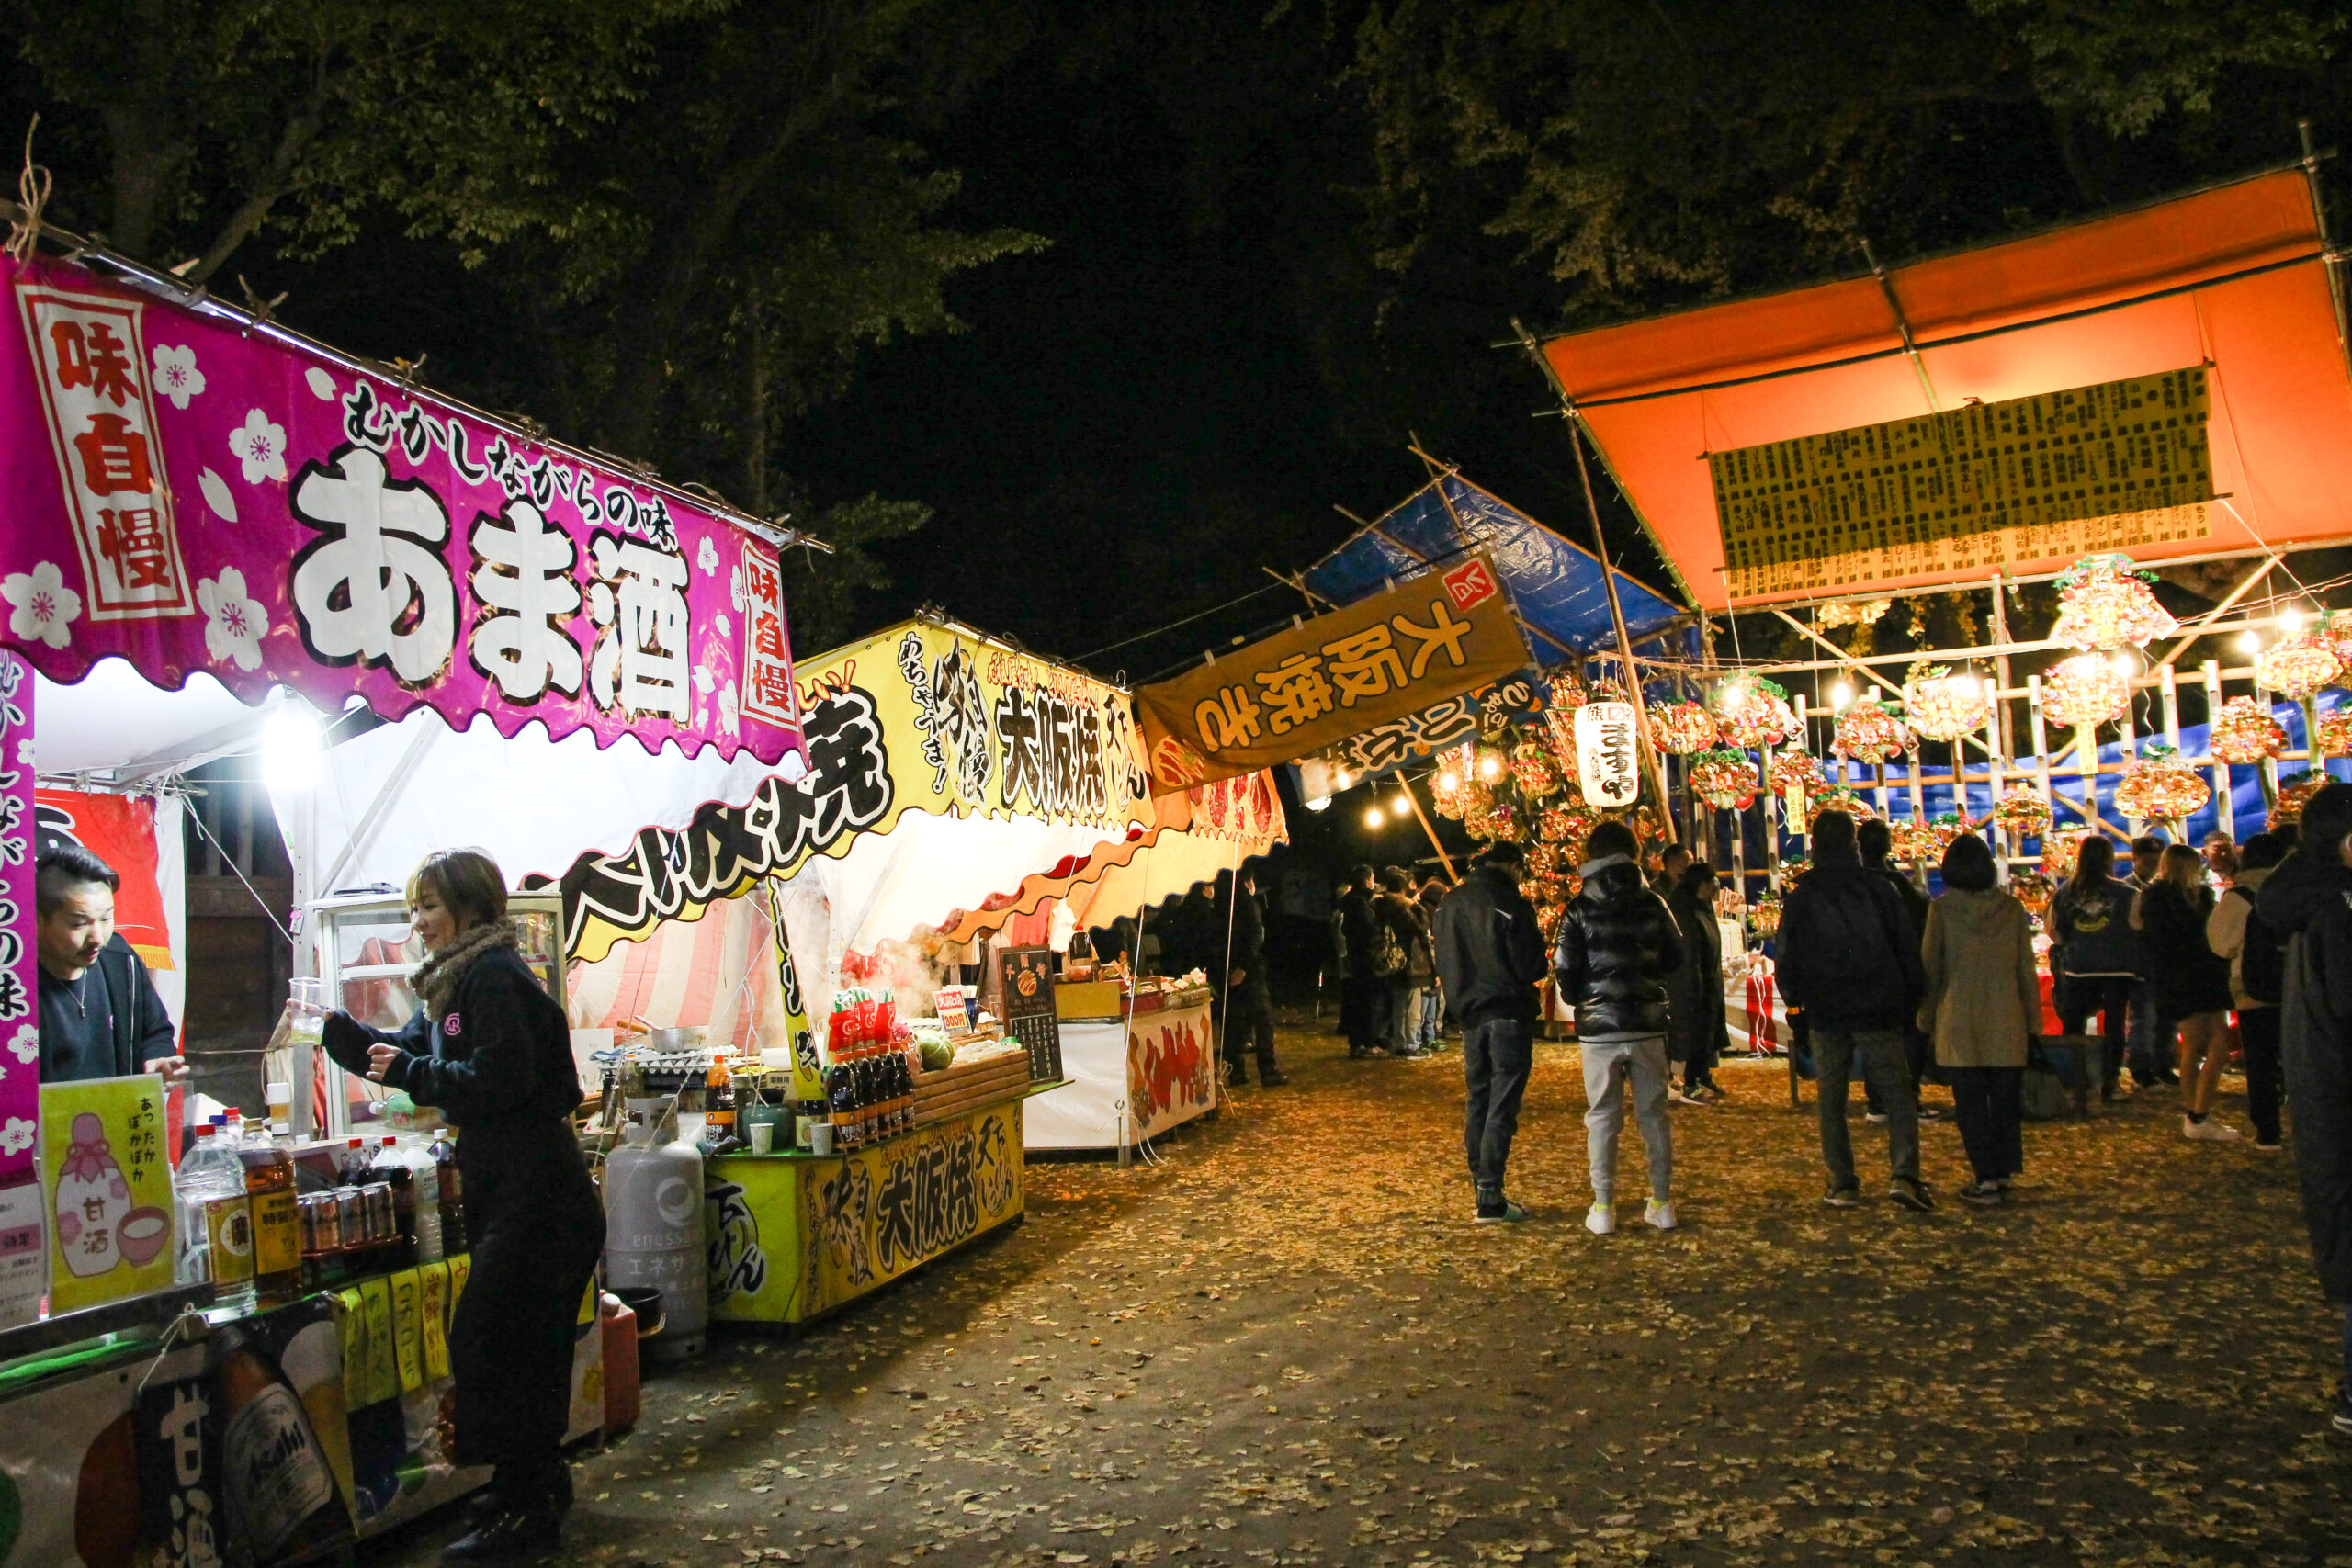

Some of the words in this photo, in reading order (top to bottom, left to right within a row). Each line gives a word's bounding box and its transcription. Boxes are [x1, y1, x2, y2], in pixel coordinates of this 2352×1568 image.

[50, 319, 171, 591] 味自慢
[344, 380, 679, 551] むかしながらの味
[288, 441, 691, 729] あま酒
[746, 559, 793, 714] 味自慢
[994, 682, 1108, 816] 大阪焼
[1194, 600, 1473, 752] 大阪焼き
[944, 1013, 966, 1027] 300円
[140, 1097, 156, 1164] あったか
[876, 1132, 979, 1275] 大阪焼
[82, 1196, 108, 1255] 甘酒
